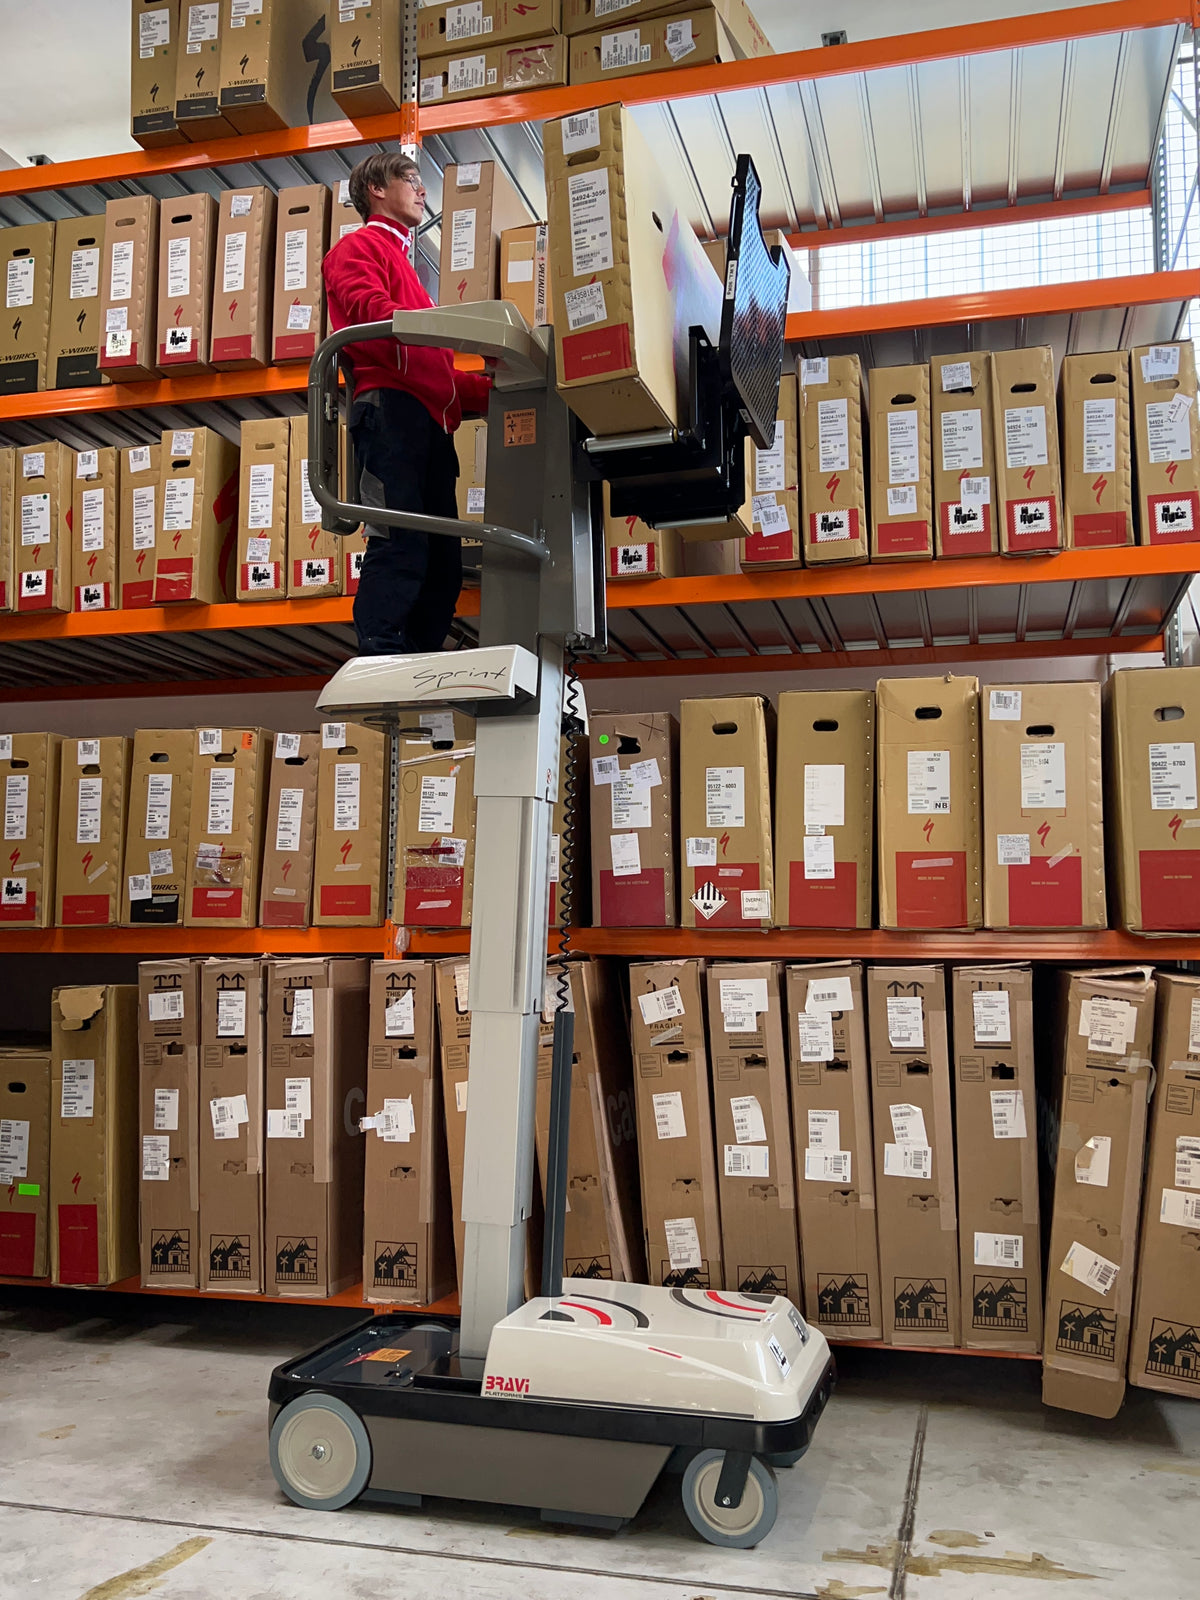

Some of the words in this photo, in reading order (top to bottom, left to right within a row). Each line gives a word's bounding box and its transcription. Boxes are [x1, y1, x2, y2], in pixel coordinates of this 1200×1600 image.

[60, 346, 98, 355] S-WORK
[0, 352, 37, 362] -WORKS
[413, 666, 506, 688] Sprint
